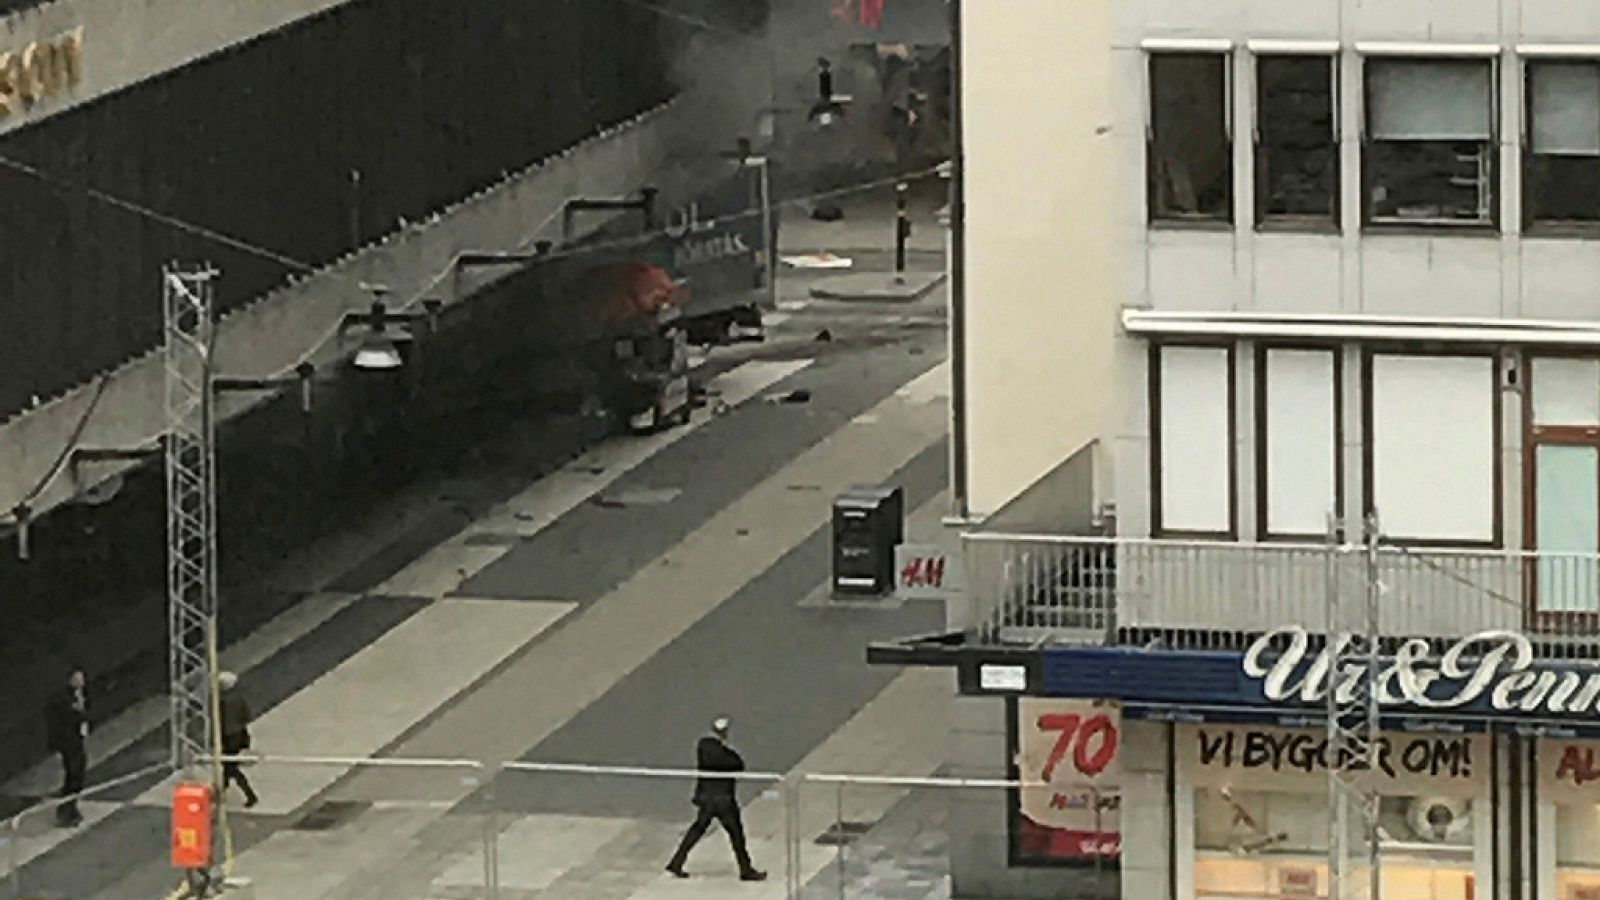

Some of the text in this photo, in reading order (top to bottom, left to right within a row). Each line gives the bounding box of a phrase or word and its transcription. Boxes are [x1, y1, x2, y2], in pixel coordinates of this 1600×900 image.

[1037, 714, 1117, 783] 70
[1199, 729, 1233, 768] VI
[1402, 738, 1471, 778] OM!
